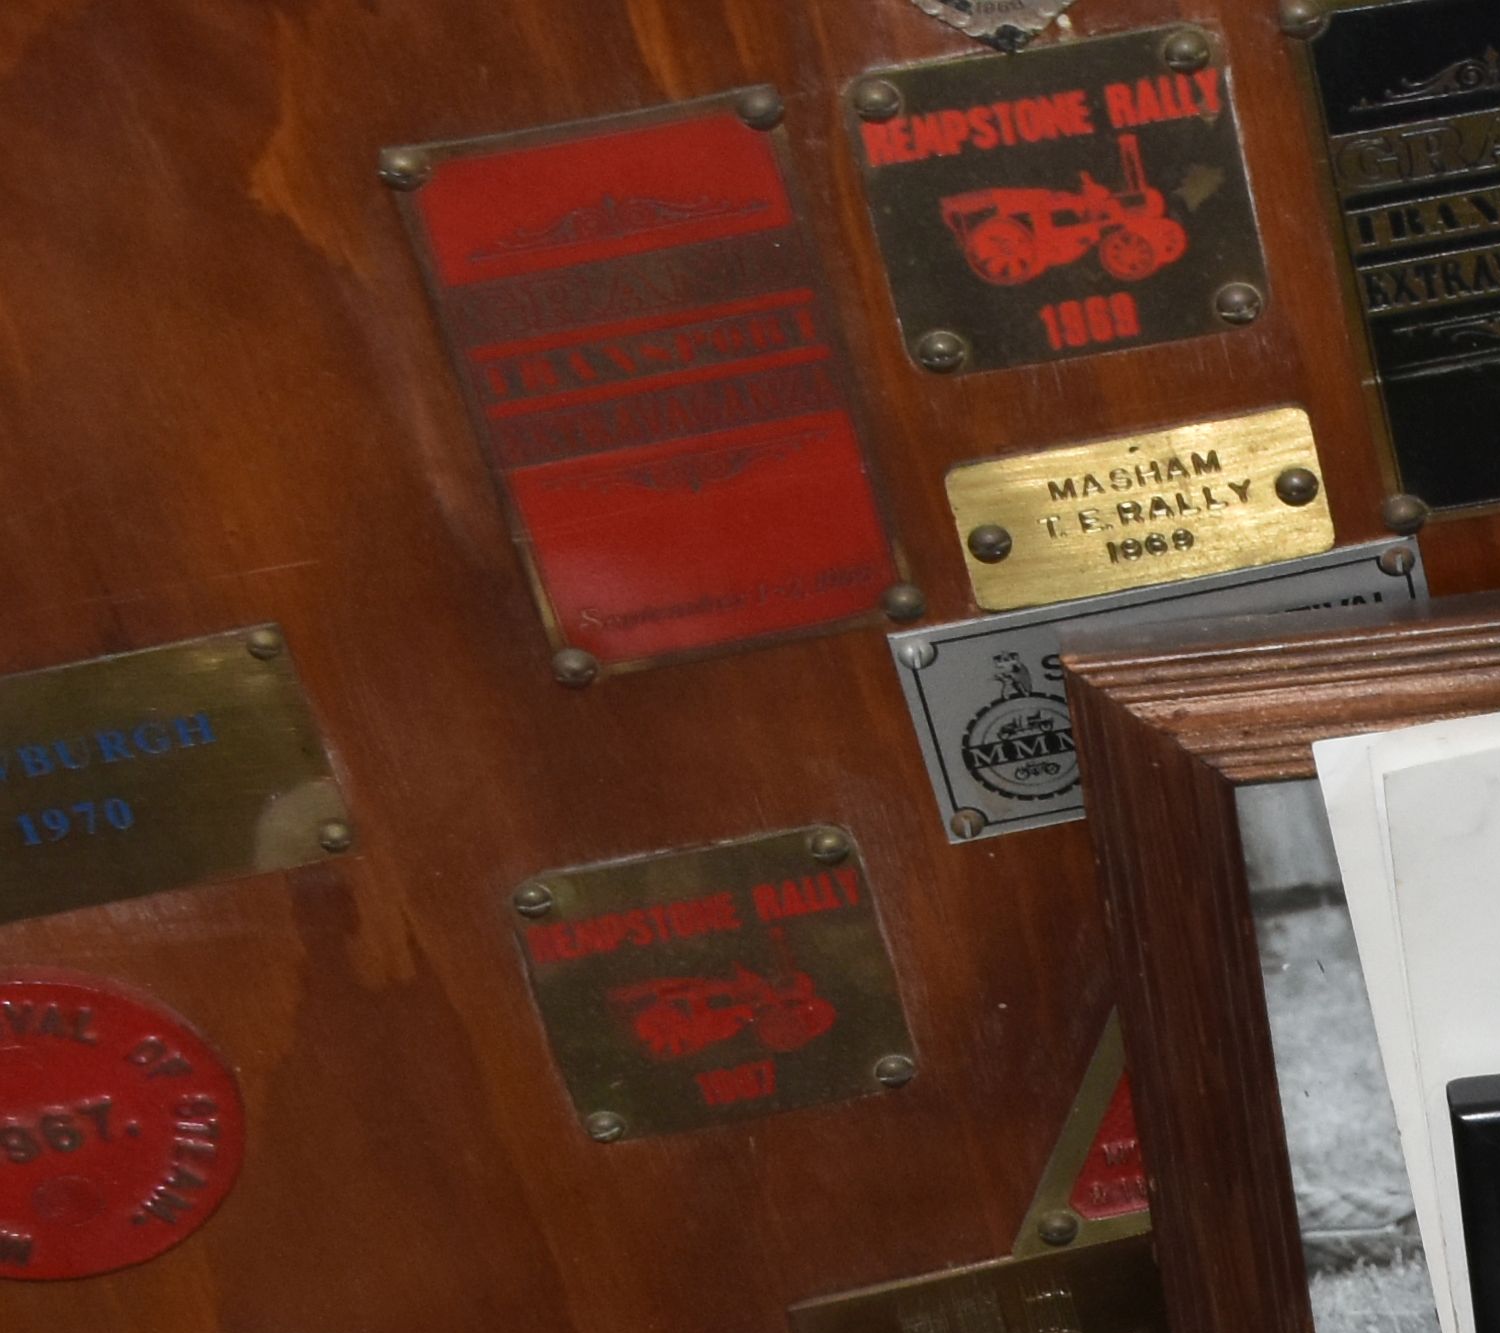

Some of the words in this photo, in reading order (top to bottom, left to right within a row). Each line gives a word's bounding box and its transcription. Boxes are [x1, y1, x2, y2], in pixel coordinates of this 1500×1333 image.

[1105, 68, 1220, 129] RALLY
[1047, 449, 1222, 501] MASHAM
[1107, 529, 1194, 564] 1969
[17, 797, 135, 846] 1970
